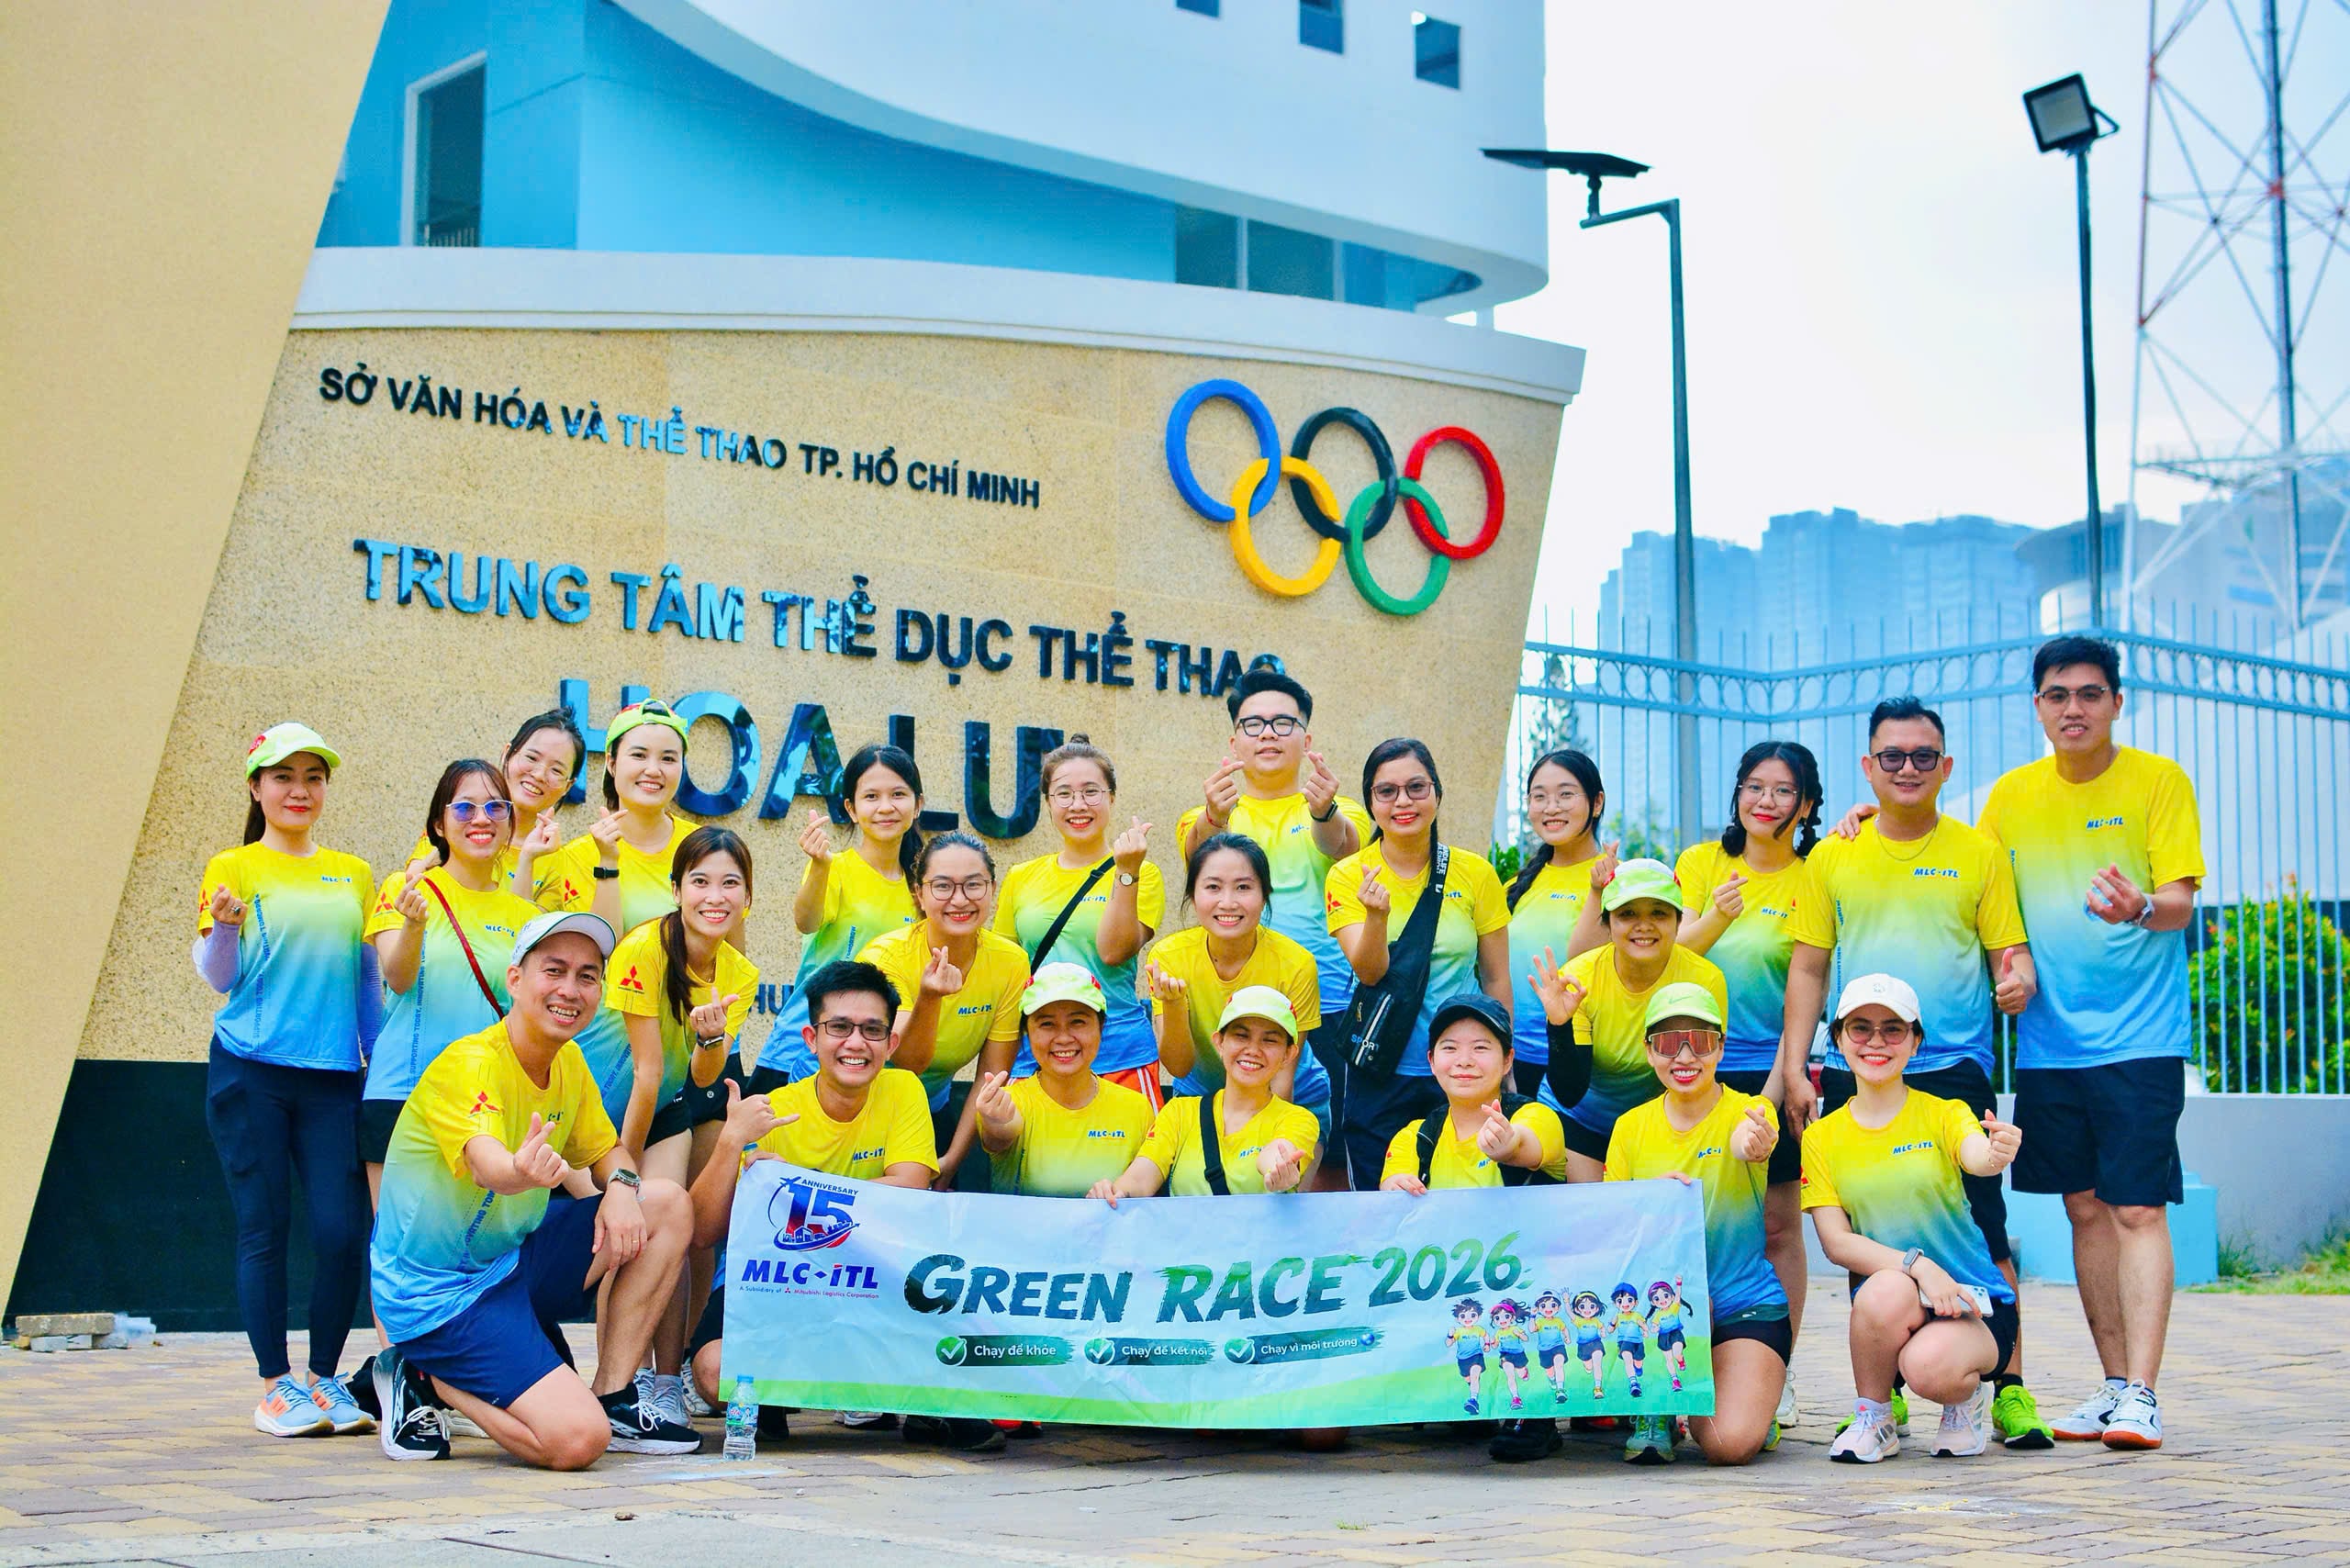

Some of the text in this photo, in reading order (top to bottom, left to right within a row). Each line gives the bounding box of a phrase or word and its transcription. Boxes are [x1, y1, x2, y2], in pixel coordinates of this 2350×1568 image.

[319, 362, 1041, 509] SỞ VĂN HÓA VÀ THỂ THAO TP. HỒ CHÍ MINH
[353, 539, 590, 625] TRUNG
[610, 563, 745, 643] TÂM
[762, 574, 878, 658] THỂ
[896, 608, 1014, 686] DỤC
[1029, 610, 1135, 688] THỂ
[853, 1148, 885, 1160] MLC-iT
[801, 1179, 858, 1195] ANNIVERSARY
[786, 1183, 856, 1247] 15
[904, 1230, 1526, 1323] GREEN RACE 2026
[745, 1285, 775, 1294] Subsidiary
[974, 1343, 1057, 1358] Chạy để khỏe
[1122, 1346, 1150, 1358] Chạy
[1153, 1344, 1168, 1356] để
[1261, 1338, 1358, 1355] Chạy vì môi trường
